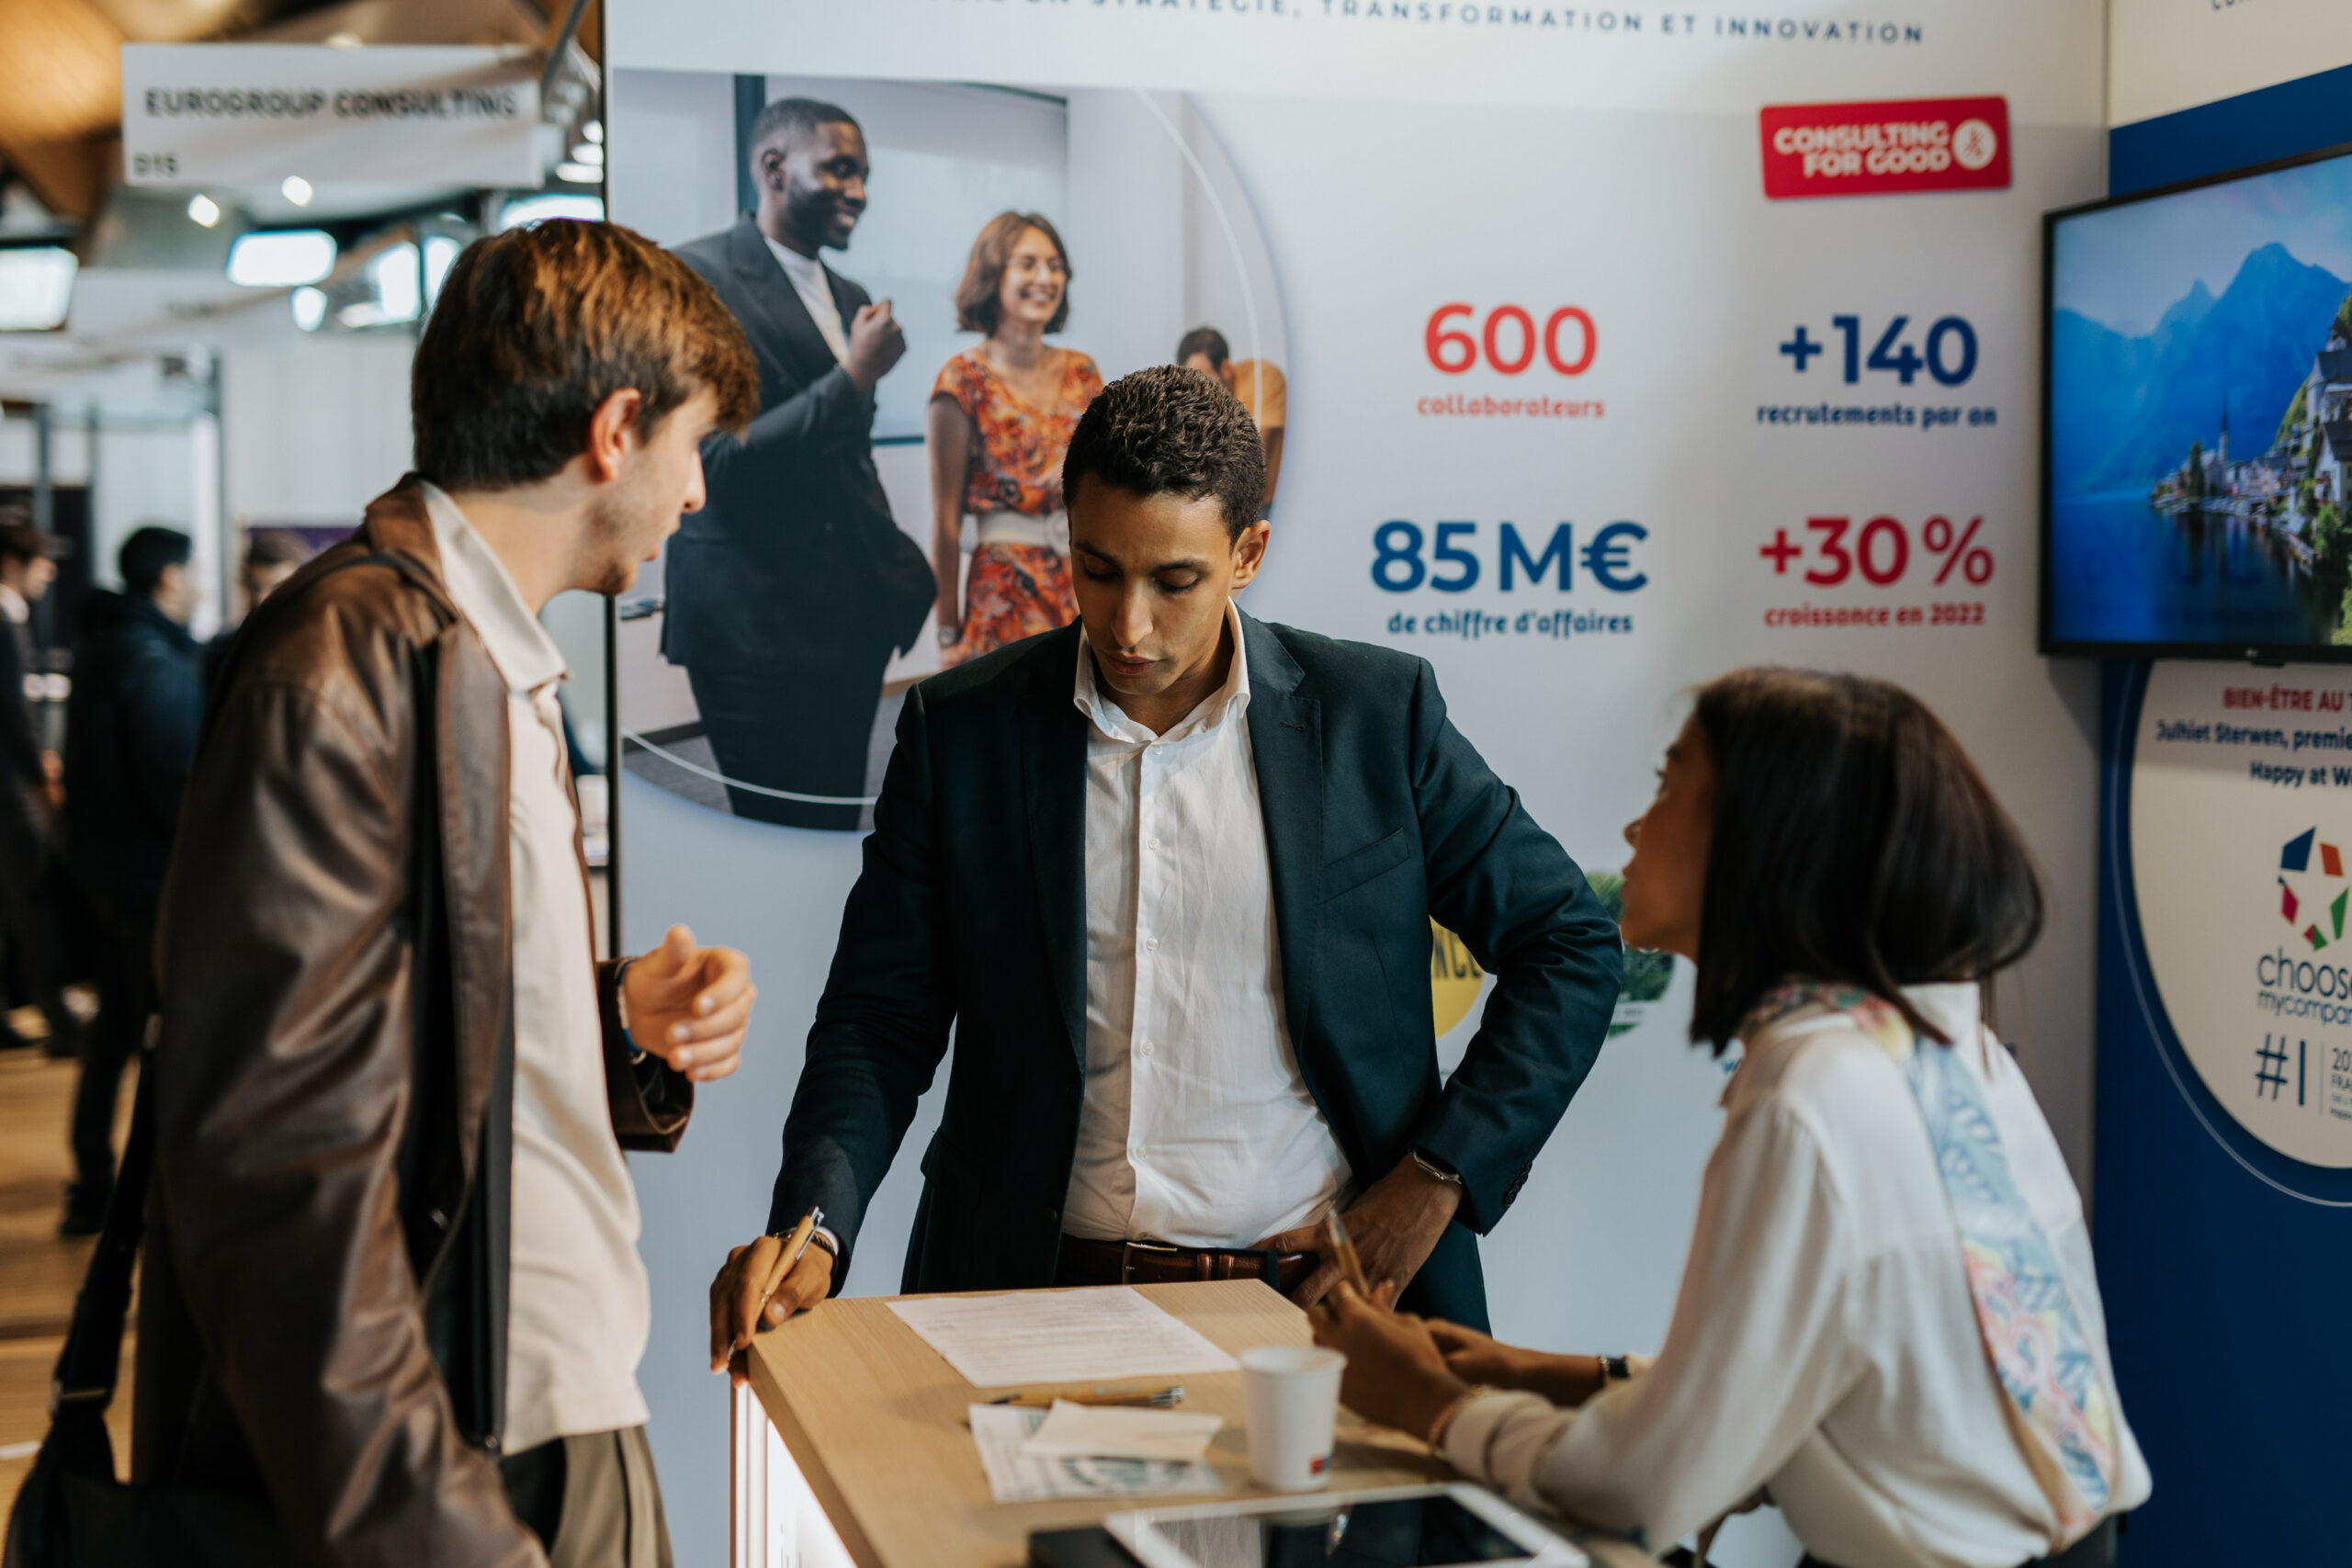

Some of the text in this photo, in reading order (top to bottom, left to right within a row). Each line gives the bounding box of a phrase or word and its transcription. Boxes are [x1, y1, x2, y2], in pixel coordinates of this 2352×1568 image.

[1320, 0, 1642, 30] TRANSFORMATION
[1661, 14, 1696, 34] ET
[1714, 16, 1922, 44] INNOVATION
[145, 89, 517, 119] EUROGROUP CONSULTING
[1773, 120, 1951, 154] CONSULTING
[1803, 147, 1951, 178] FOR GOOD
[1425, 302, 1597, 378] 600
[1779, 315, 1979, 389] +140
[1417, 394, 1605, 418] collaborateurs
[1757, 401, 1997, 432] recrutements par an
[1387, 610, 1633, 639] de chiffre d'affaires
[1764, 602, 1984, 626] croissance en 2022
[2223, 683, 2312, 711] BIEN-ÊTRE
[2317, 689, 2344, 713] AU
[2250, 761, 2352, 789] Happy at W
[2257, 946, 2352, 1002] choos
[2257, 990, 2352, 1028] mycompa
[2333, 1047, 2352, 1073] 20
